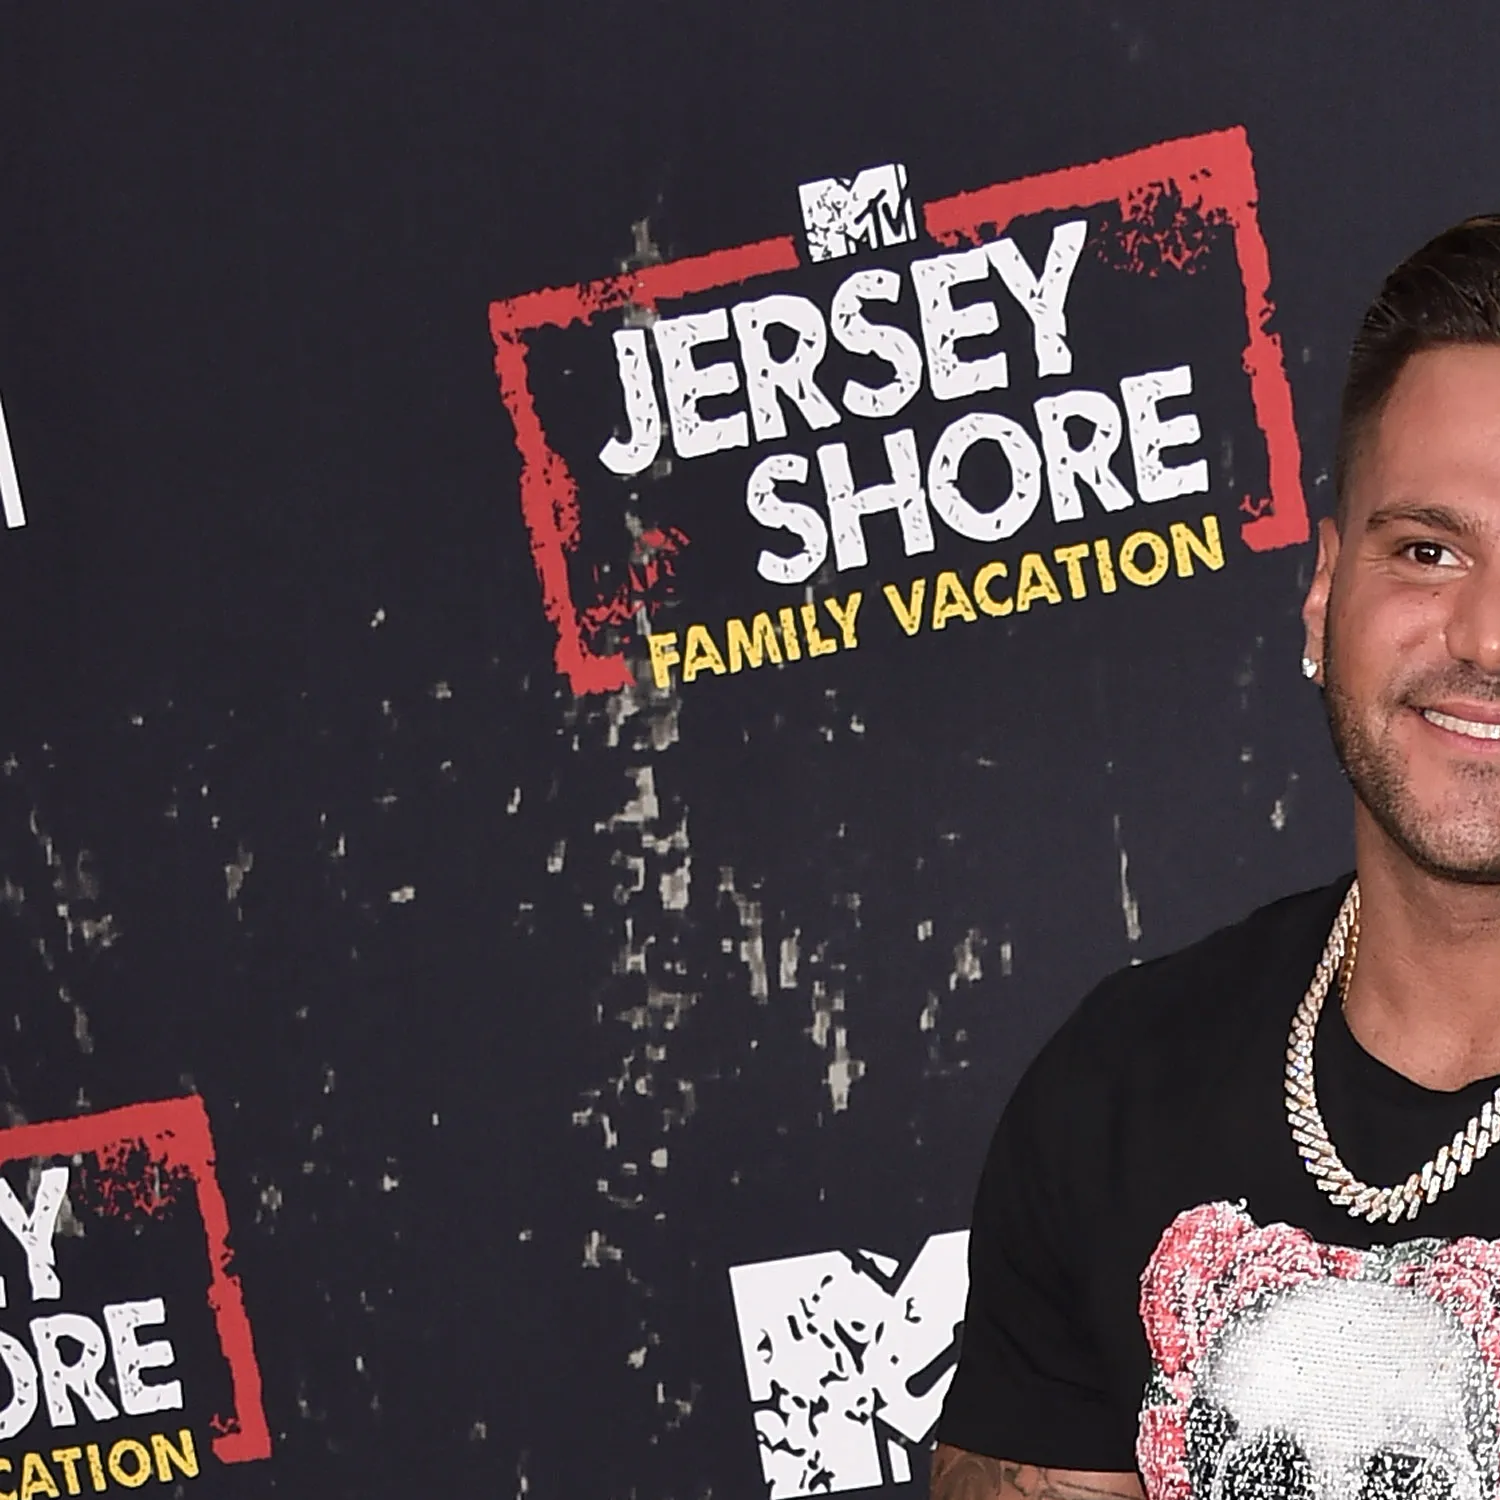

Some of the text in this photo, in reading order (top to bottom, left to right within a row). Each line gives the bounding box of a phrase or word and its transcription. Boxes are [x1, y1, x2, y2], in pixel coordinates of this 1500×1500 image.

[798, 162, 917, 263] MTV
[599, 220, 1088, 475] JERSEY
[745, 365, 1210, 585] SHORE
[648, 514, 1226, 688] FAMILY VACATION
